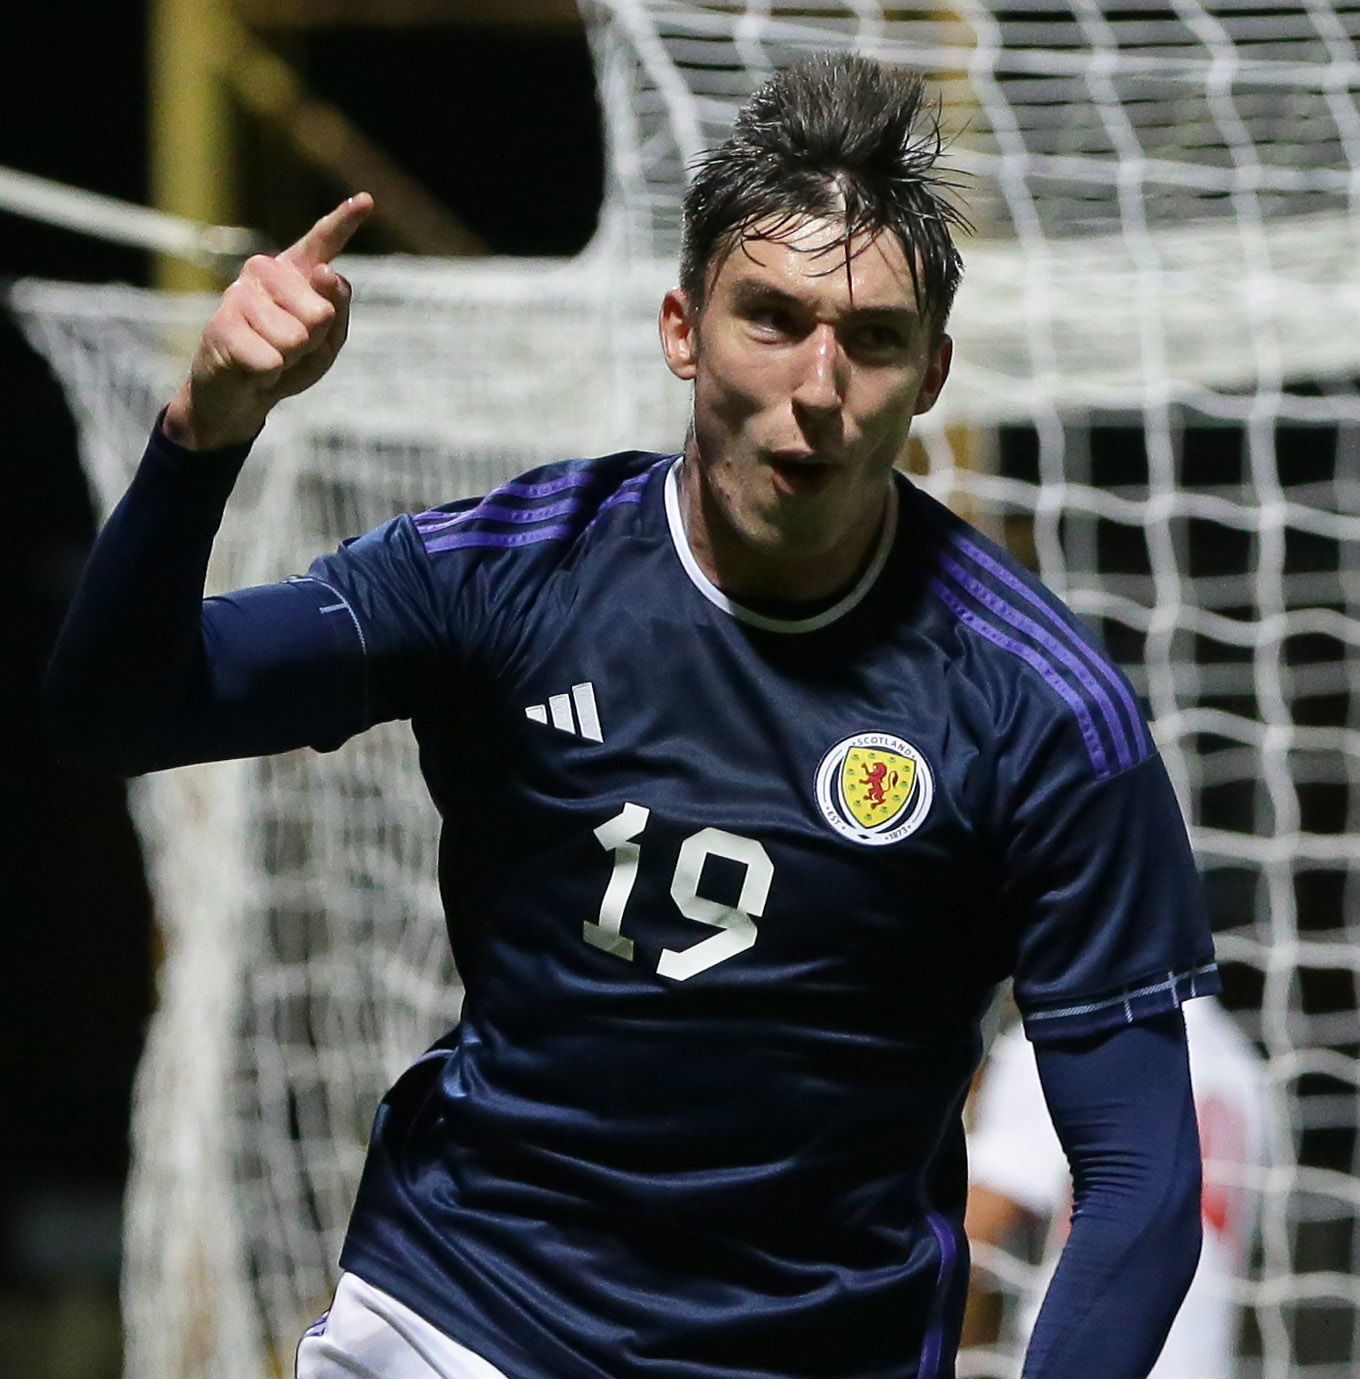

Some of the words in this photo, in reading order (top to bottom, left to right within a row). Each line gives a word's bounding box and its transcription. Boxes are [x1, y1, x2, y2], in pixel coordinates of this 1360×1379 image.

[856, 735, 913, 757] SCOTLAND
[826, 809, 842, 826] EST
[888, 825, 909, 841] 1873
[582, 802, 775, 982] 19
